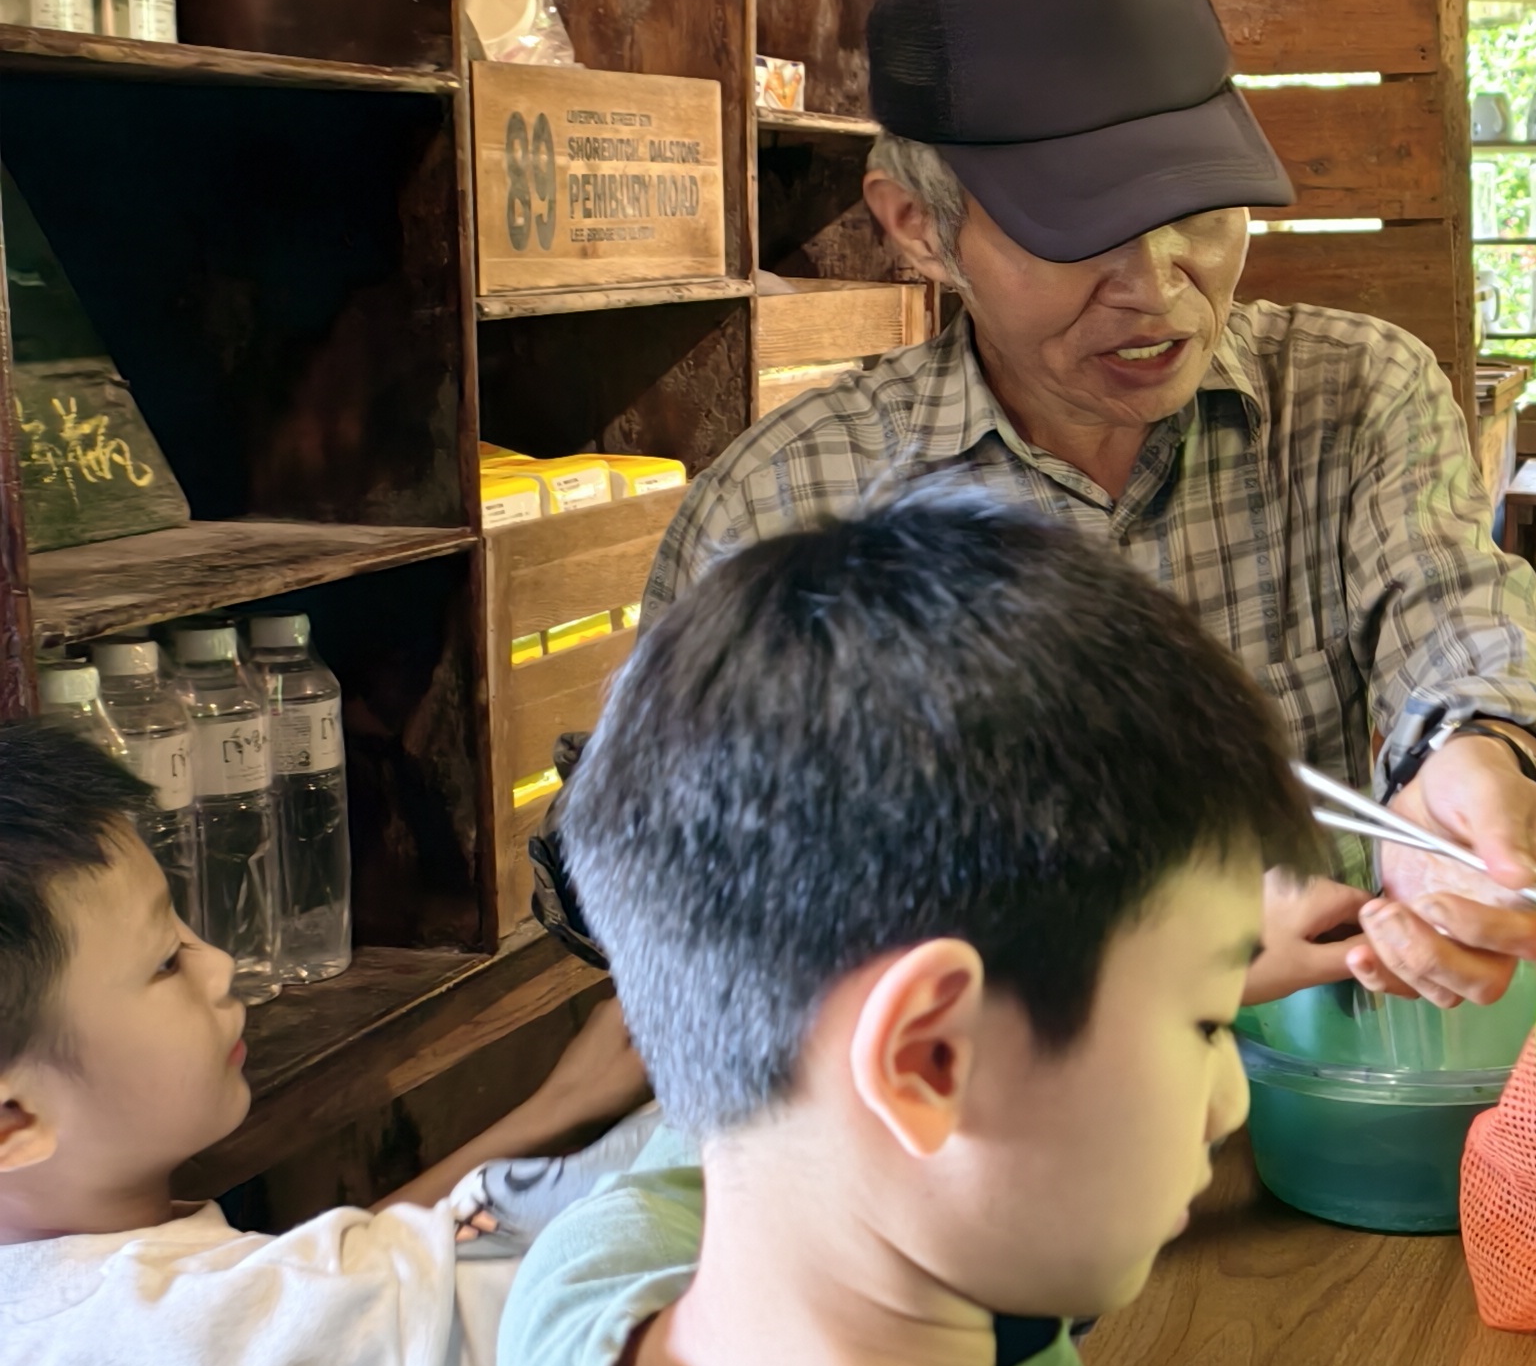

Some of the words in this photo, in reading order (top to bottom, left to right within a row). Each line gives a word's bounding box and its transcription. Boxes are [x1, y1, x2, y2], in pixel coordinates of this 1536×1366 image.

[506, 110, 557, 252] 89
[568, 173, 651, 220] PEMBURY
[656, 174, 700, 218] ROAD
